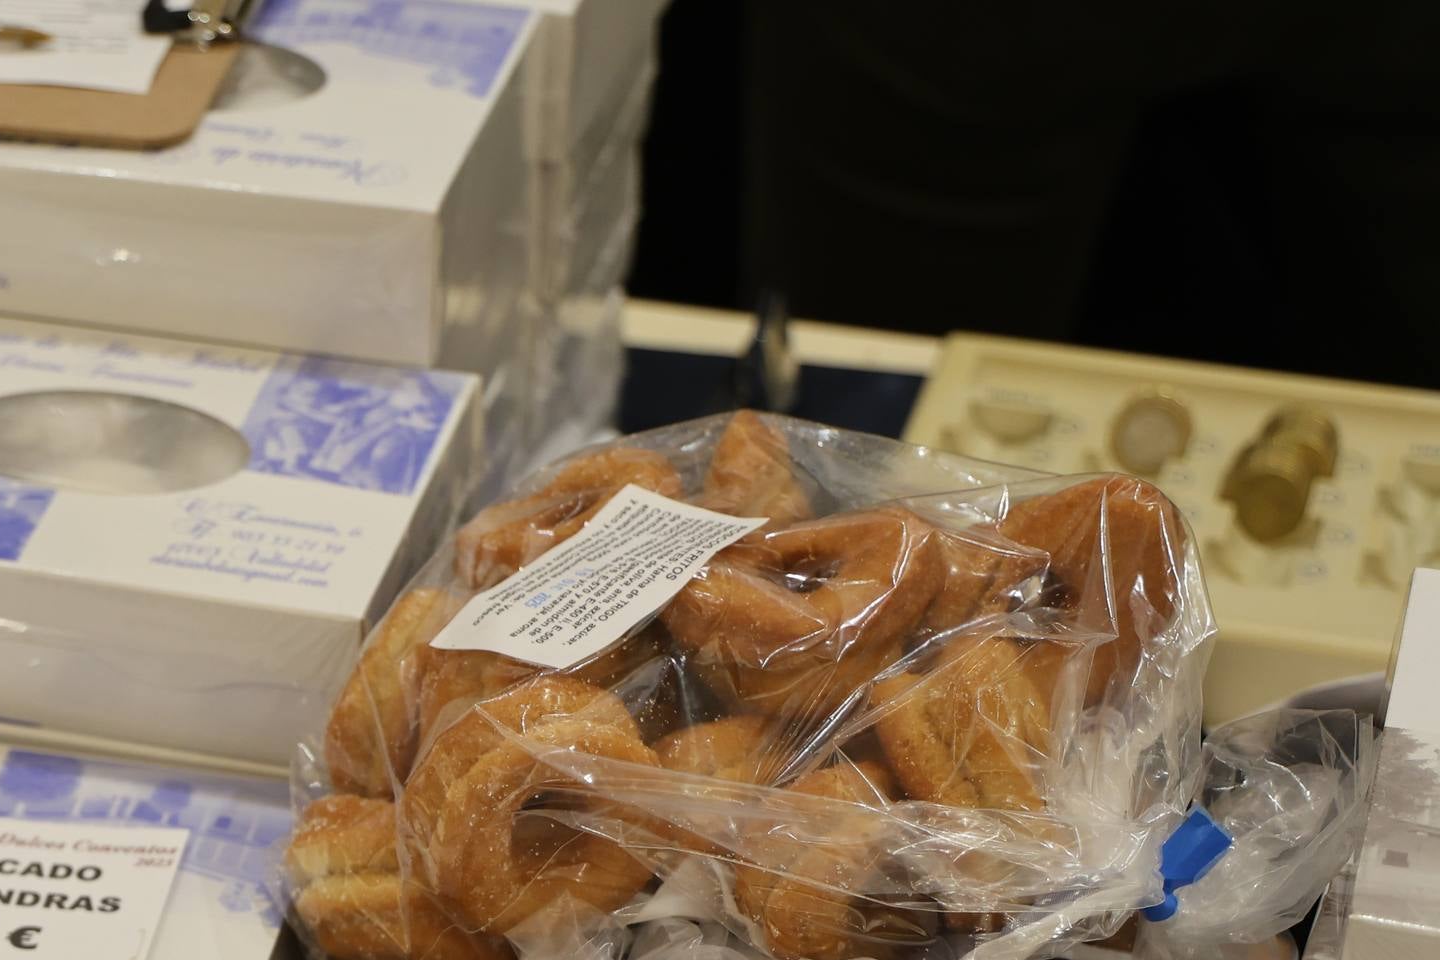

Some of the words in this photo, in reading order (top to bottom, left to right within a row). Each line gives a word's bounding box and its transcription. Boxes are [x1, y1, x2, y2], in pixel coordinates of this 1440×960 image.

[634, 564, 671, 588] Harina
[660, 549, 709, 580] FRITOS
[565, 597, 598, 618] E-450
[592, 598, 630, 623] TRIGO,
[507, 616, 540, 637] aroma
[6, 925, 43, 951] €
